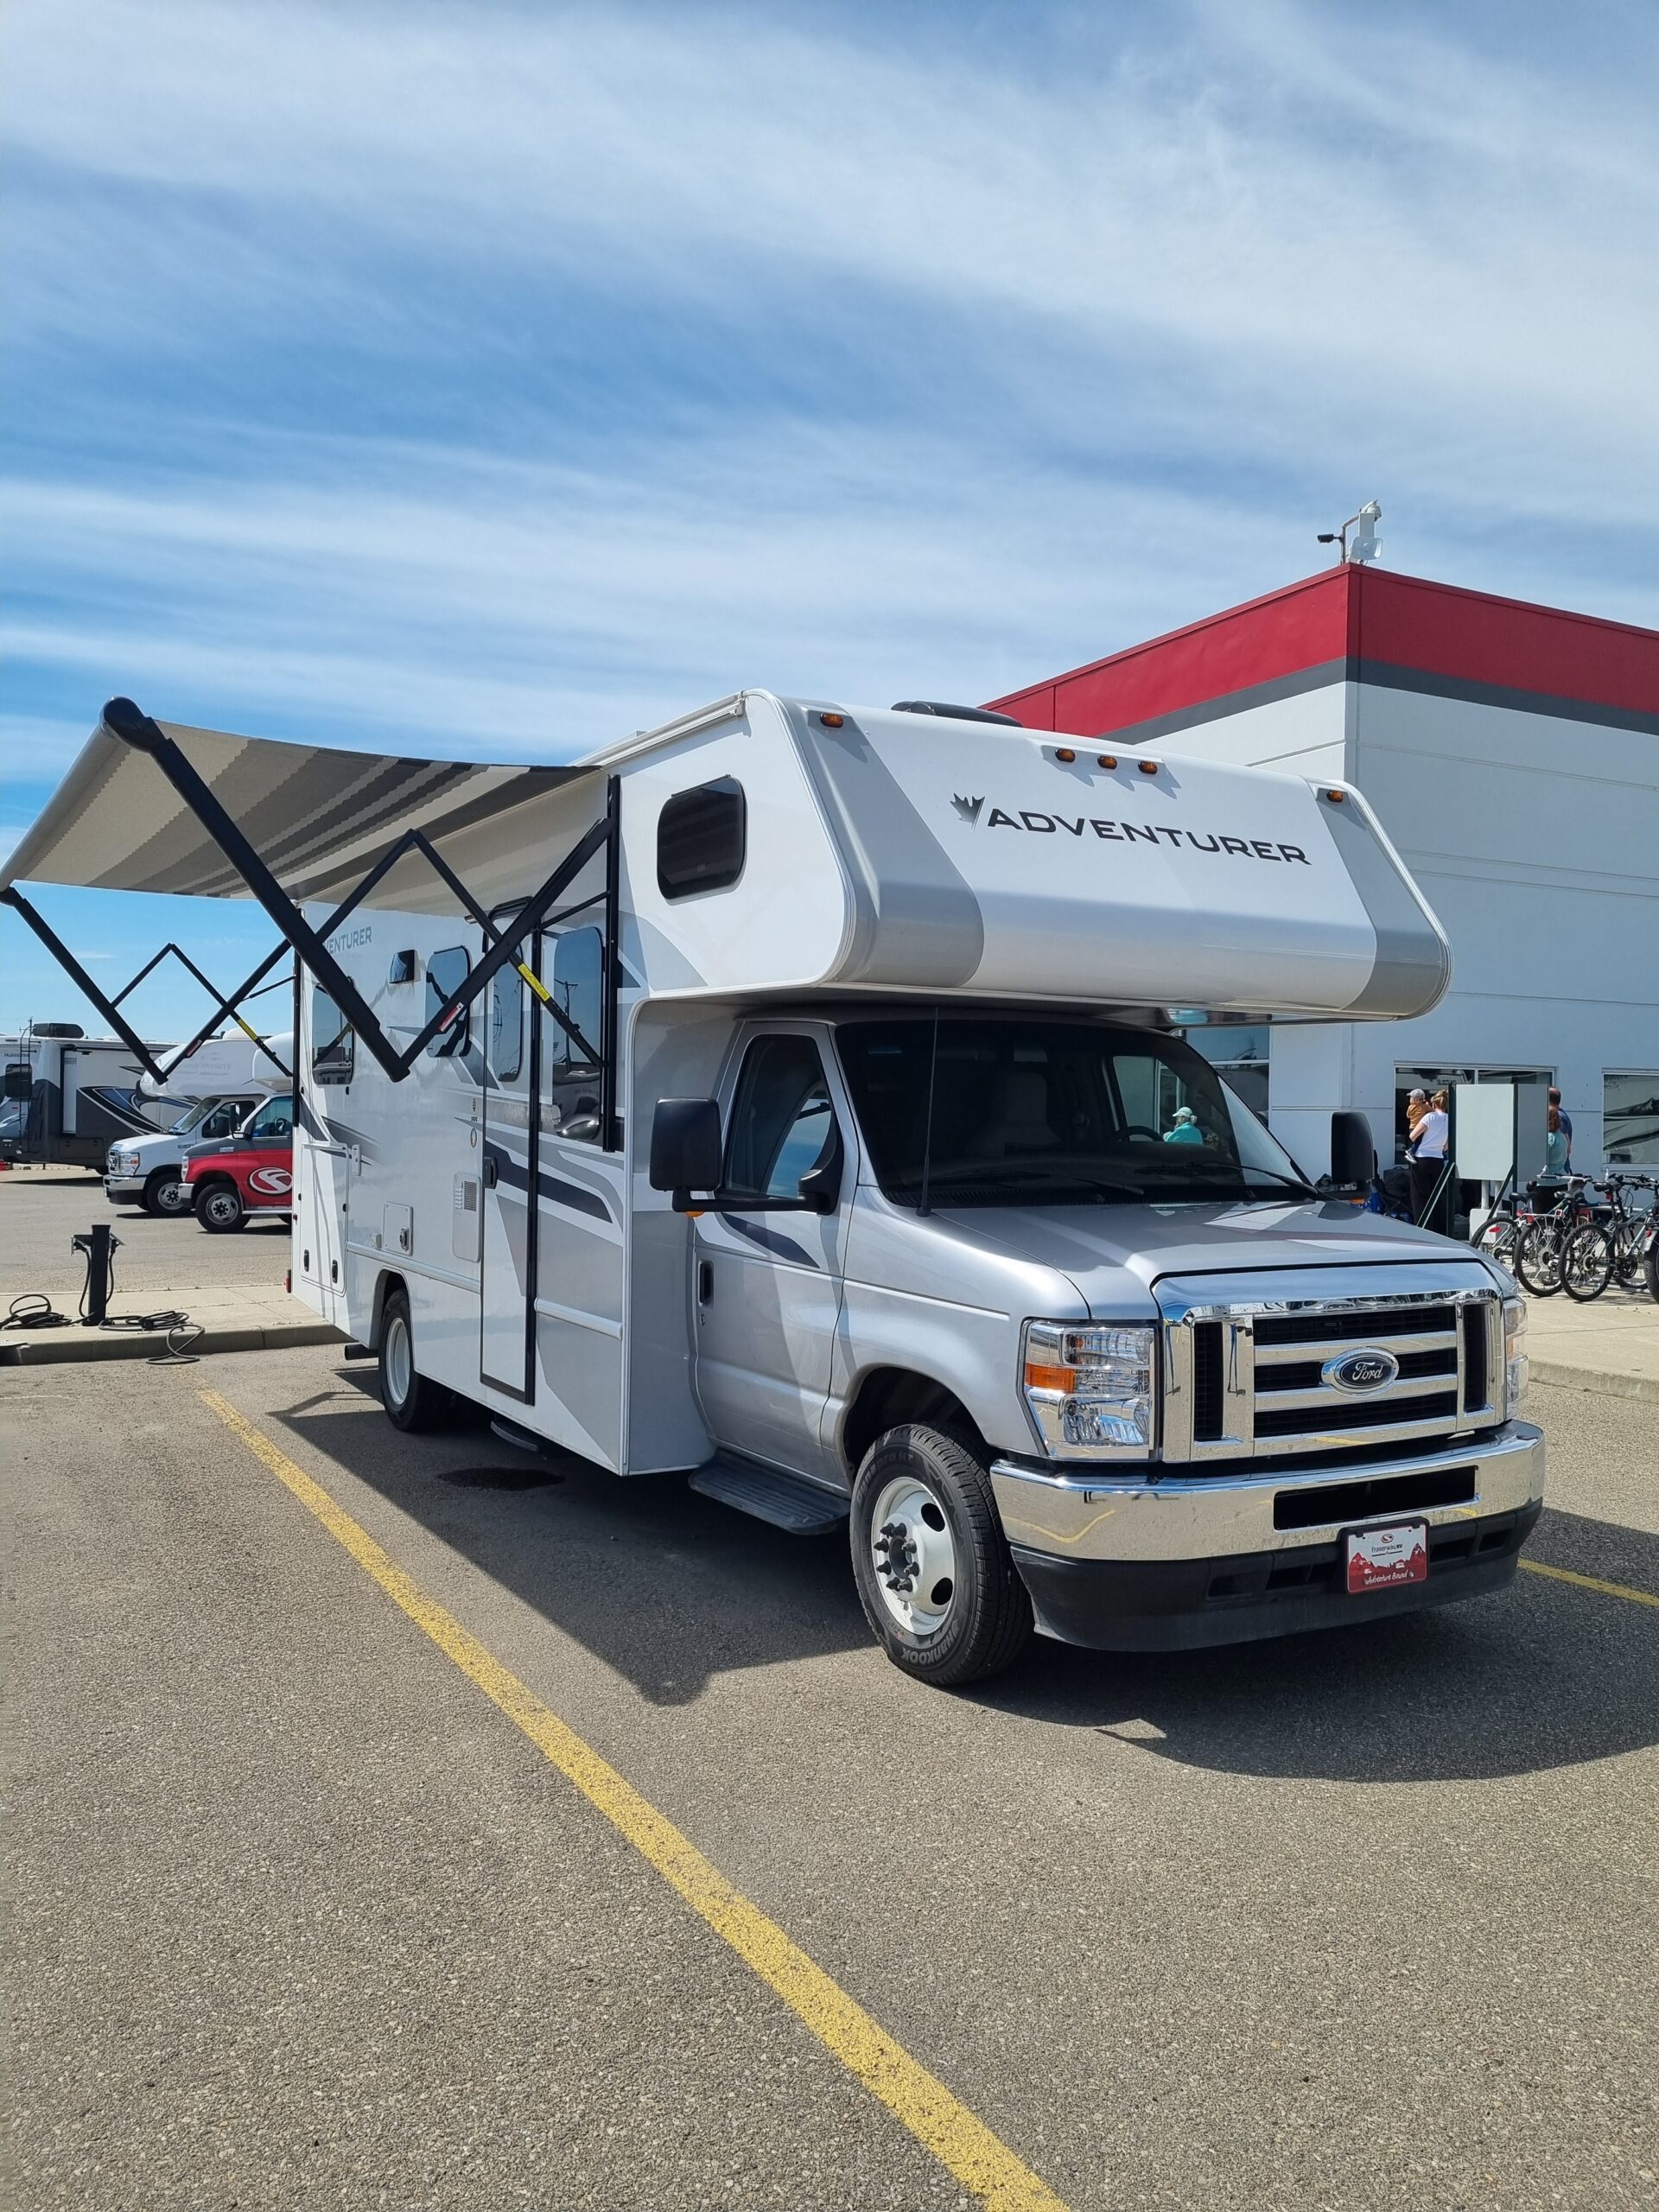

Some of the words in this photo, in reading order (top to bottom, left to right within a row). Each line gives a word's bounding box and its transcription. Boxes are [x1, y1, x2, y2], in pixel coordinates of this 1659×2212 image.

[988, 808, 1313, 865] ADVENTURER
[327, 926, 372, 954] ENTURER
[1351, 1362, 1383, 1381] Ford
